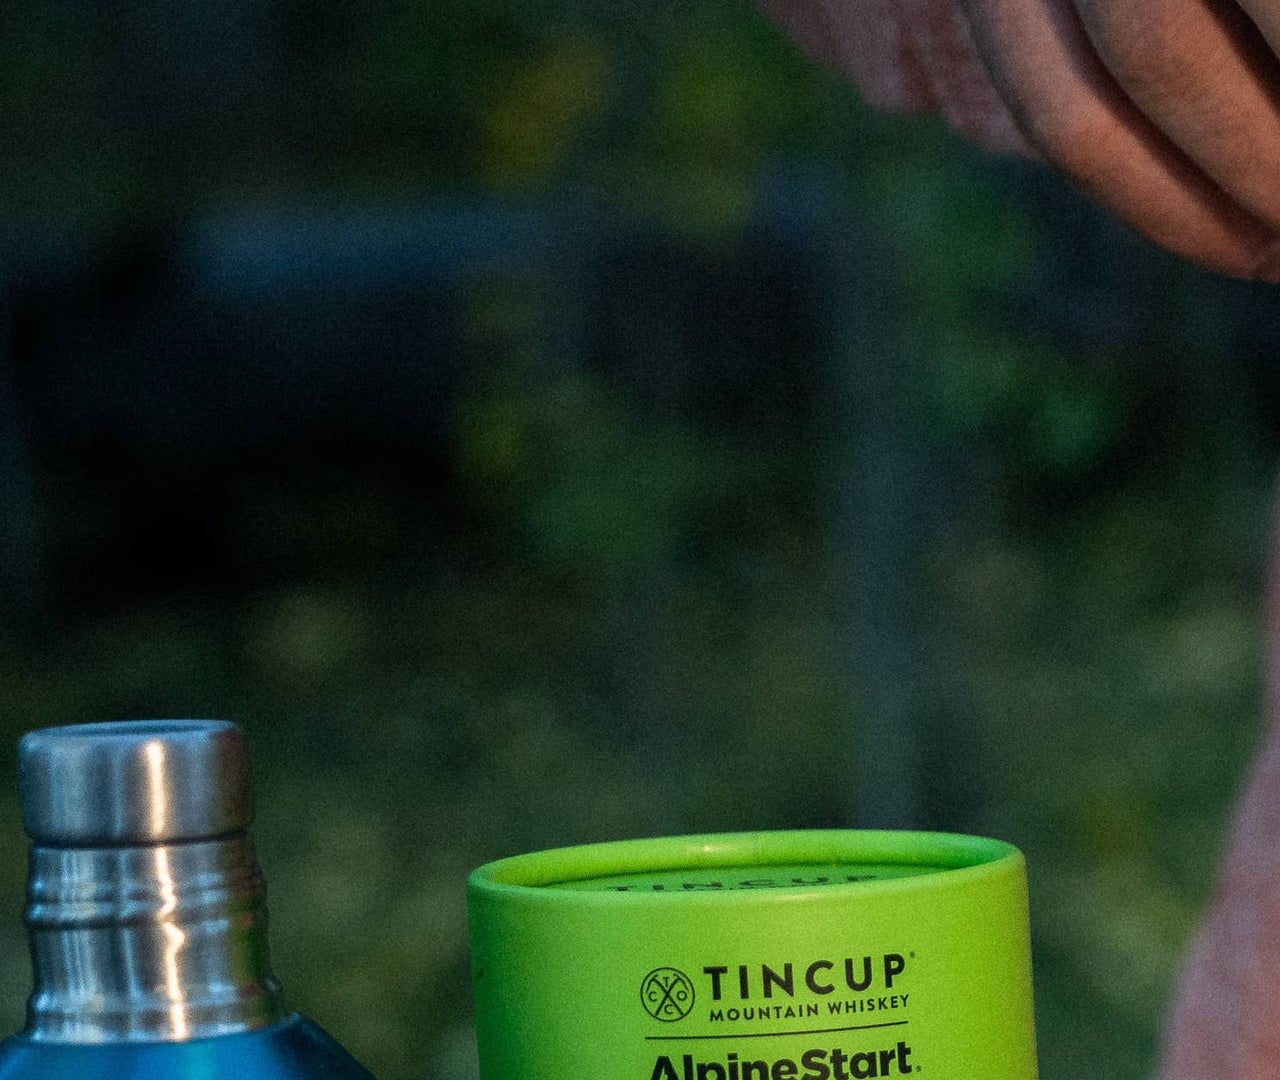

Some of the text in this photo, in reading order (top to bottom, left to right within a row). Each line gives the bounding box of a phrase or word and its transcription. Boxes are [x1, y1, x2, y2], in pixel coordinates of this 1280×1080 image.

[703, 953, 906, 1000] TINCUP
[709, 994, 910, 1022] MOUNTAIN WHISKEY
